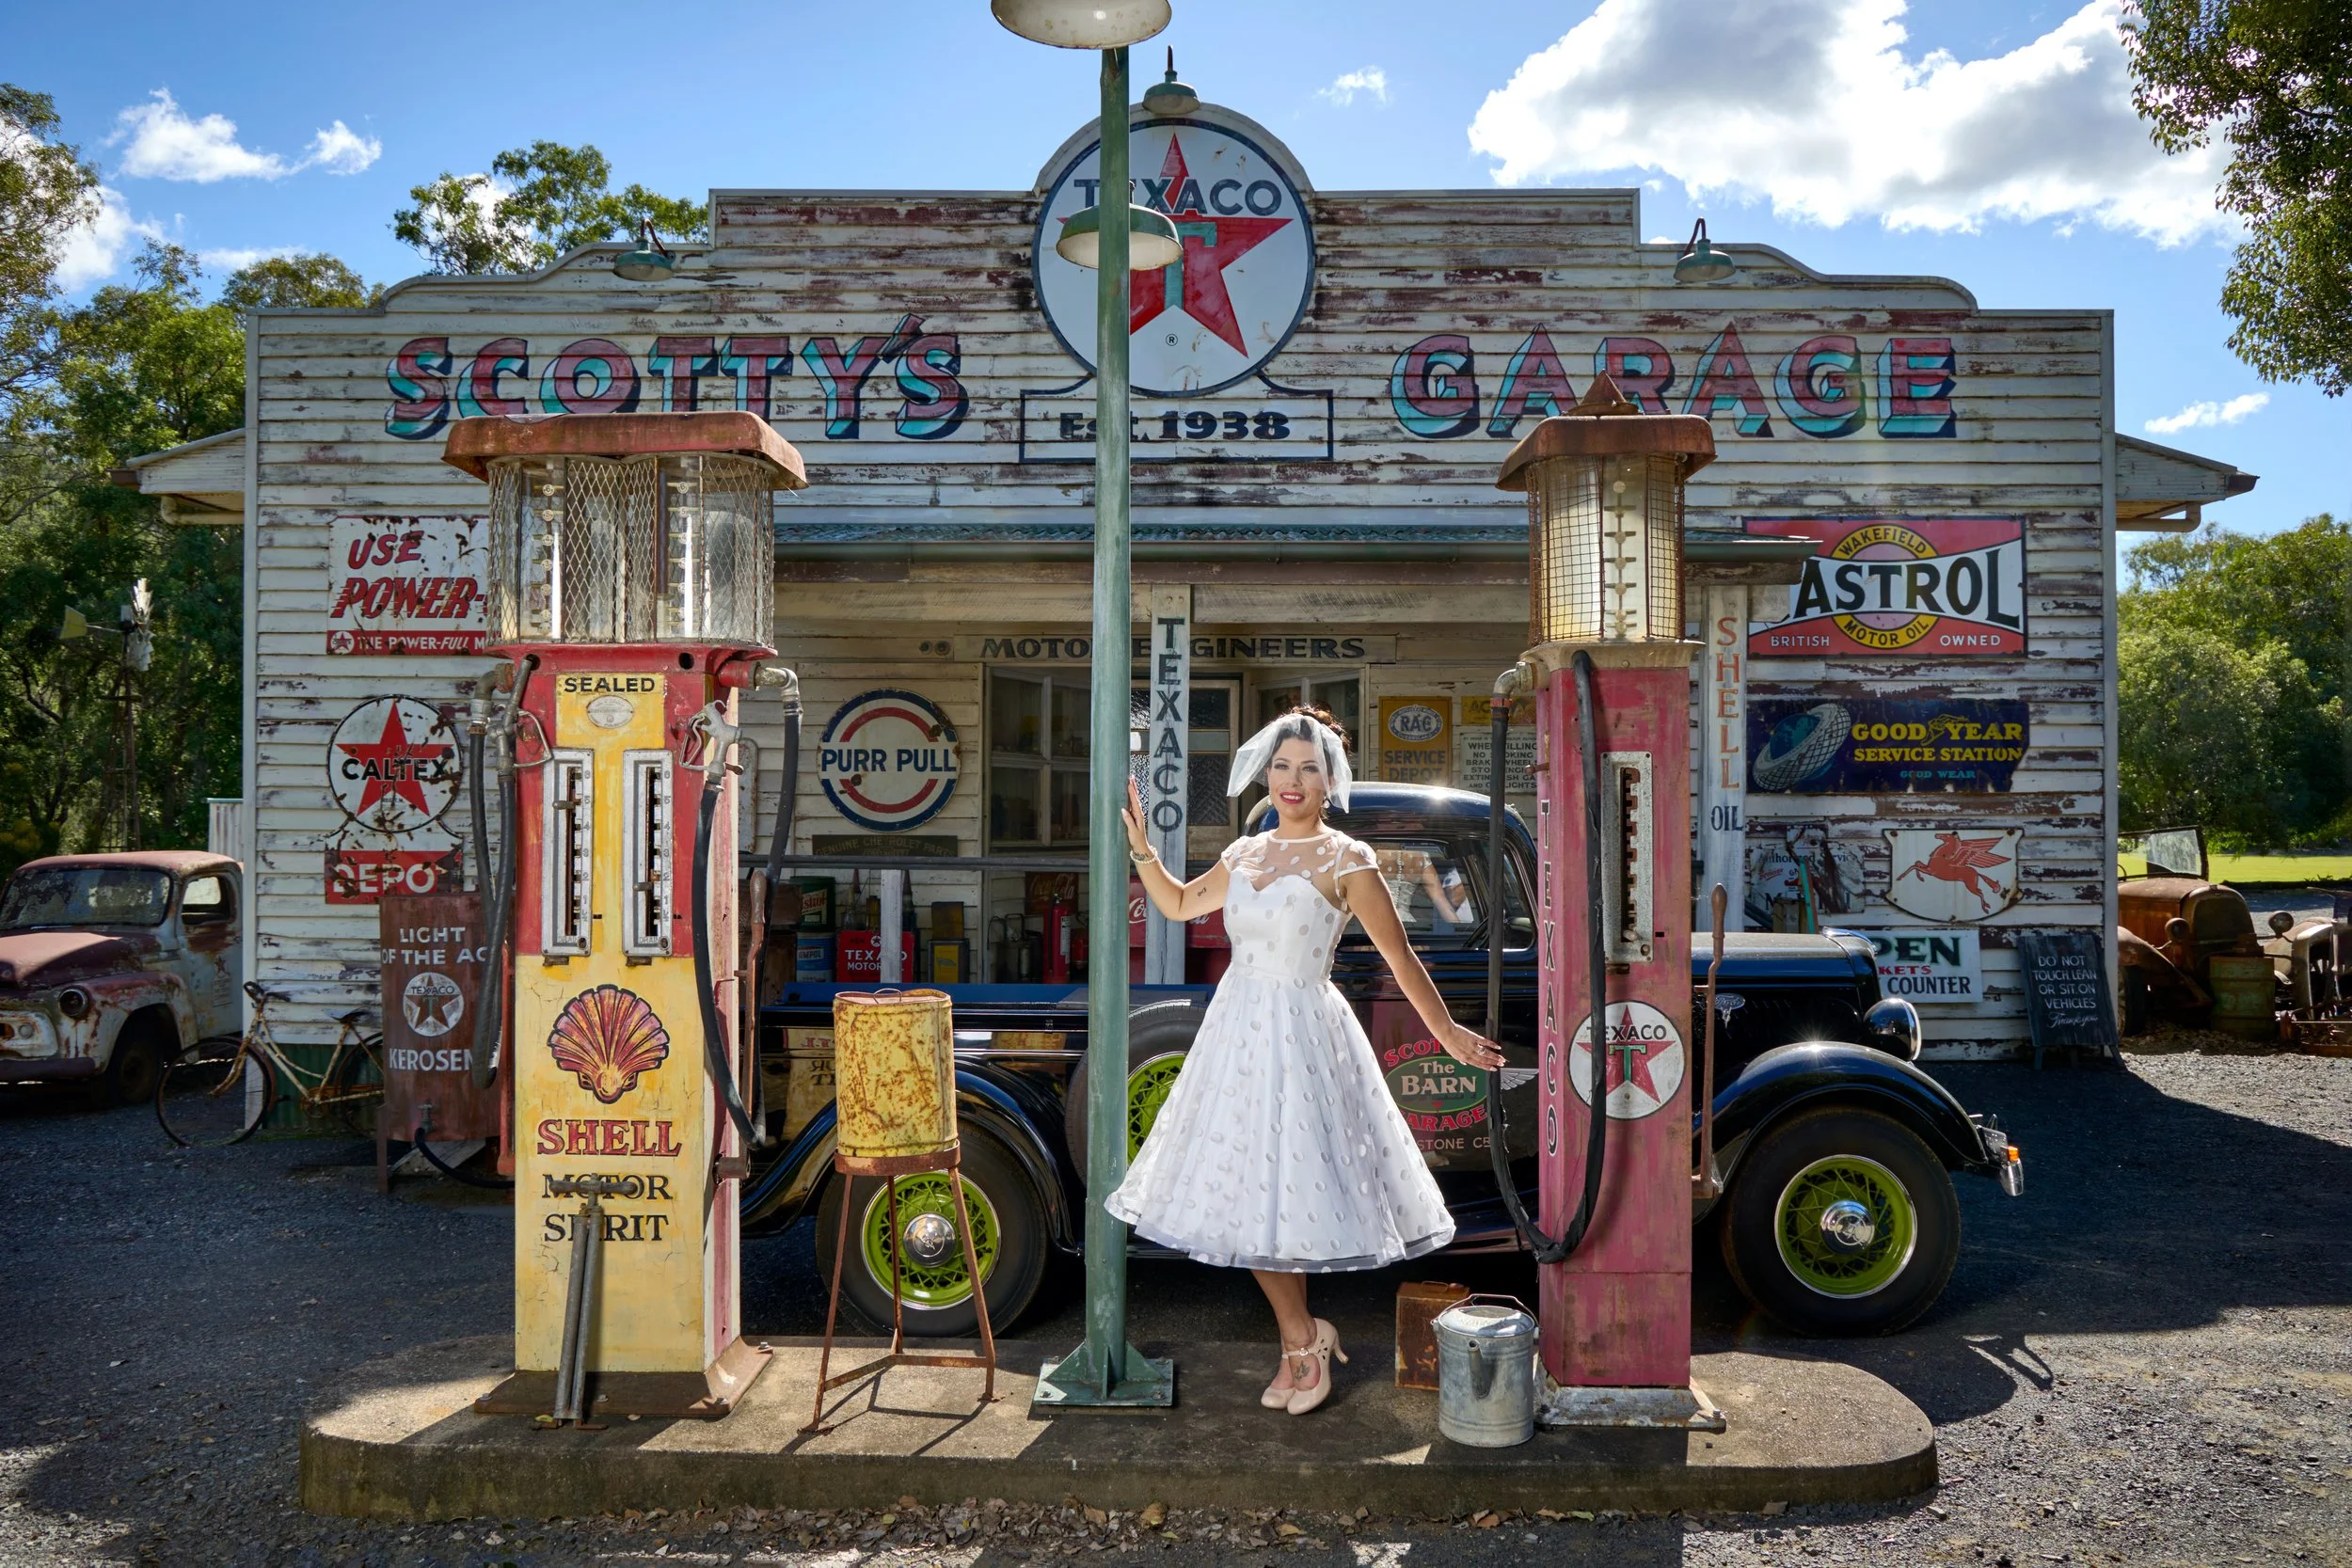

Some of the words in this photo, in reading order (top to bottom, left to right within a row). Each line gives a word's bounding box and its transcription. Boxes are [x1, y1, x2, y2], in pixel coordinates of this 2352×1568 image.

[1073, 178, 1283, 215] TXACO
[384, 313, 969, 440] SCOTTY'S
[1391, 322, 1956, 439] GARAGE
[1157, 411, 1292, 440] 1938
[348, 531, 424, 569] USE
[1839, 527, 1927, 556] WAKEFIELD
[1778, 548, 2021, 629] ASTROL
[358, 636, 383, 650] THE
[389, 636, 469, 650] POWER-FULL
[1771, 635, 1830, 647] BRITISH
[1940, 635, 2001, 647] OWNED
[1844, 620, 1899, 646] MOTOR
[1906, 619, 1930, 641] OIL
[980, 638, 1092, 659] MOTO
[1132, 637, 1366, 659] EGINEERS
[564, 677, 656, 693] SEALED
[1715, 616, 1740, 790] SHELL
[1152, 618, 1184, 833] TEXACO
[1851, 722, 1927, 740] GOOD
[1945, 722, 2023, 740] YEAR
[821, 749, 886, 772] PURR
[897, 749, 957, 772] PULL
[1384, 751, 1446, 765] SERVICE
[1853, 748, 1936, 762] SERVICE
[1940, 748, 2024, 762] STATION
[342, 757, 448, 781] CALTEX
[1389, 768, 1443, 782] DEPOT
[1709, 805, 1743, 832] OIL
[333, 863, 449, 894] DEPO
[400, 927, 466, 943] LIGHT
[382, 948, 396, 964] OF
[401, 949, 446, 965] THE
[1867, 937, 1961, 966] PEN
[2038, 956, 2057, 966] DO
[2060, 955, 2085, 966] NOT
[1541, 800, 1558, 1158] TEXACO
[1887, 976, 1971, 994] COUNTER
[2032, 970, 2069, 980] TOUCH
[2072, 969, 2097, 980] LEAN
[411, 985, 455, 995] TEXACO
[2039, 984, 2055, 994] OR
[2044, 997, 2096, 1009] VEHICLES
[389, 1048, 473, 1071] KEROSEN
[1419, 1060, 1454, 1074] The
[1401, 1075, 1477, 1096] BARN
[1406, 1104, 1487, 1132] ARAGE
[537, 1118, 683, 1157] SHELL
